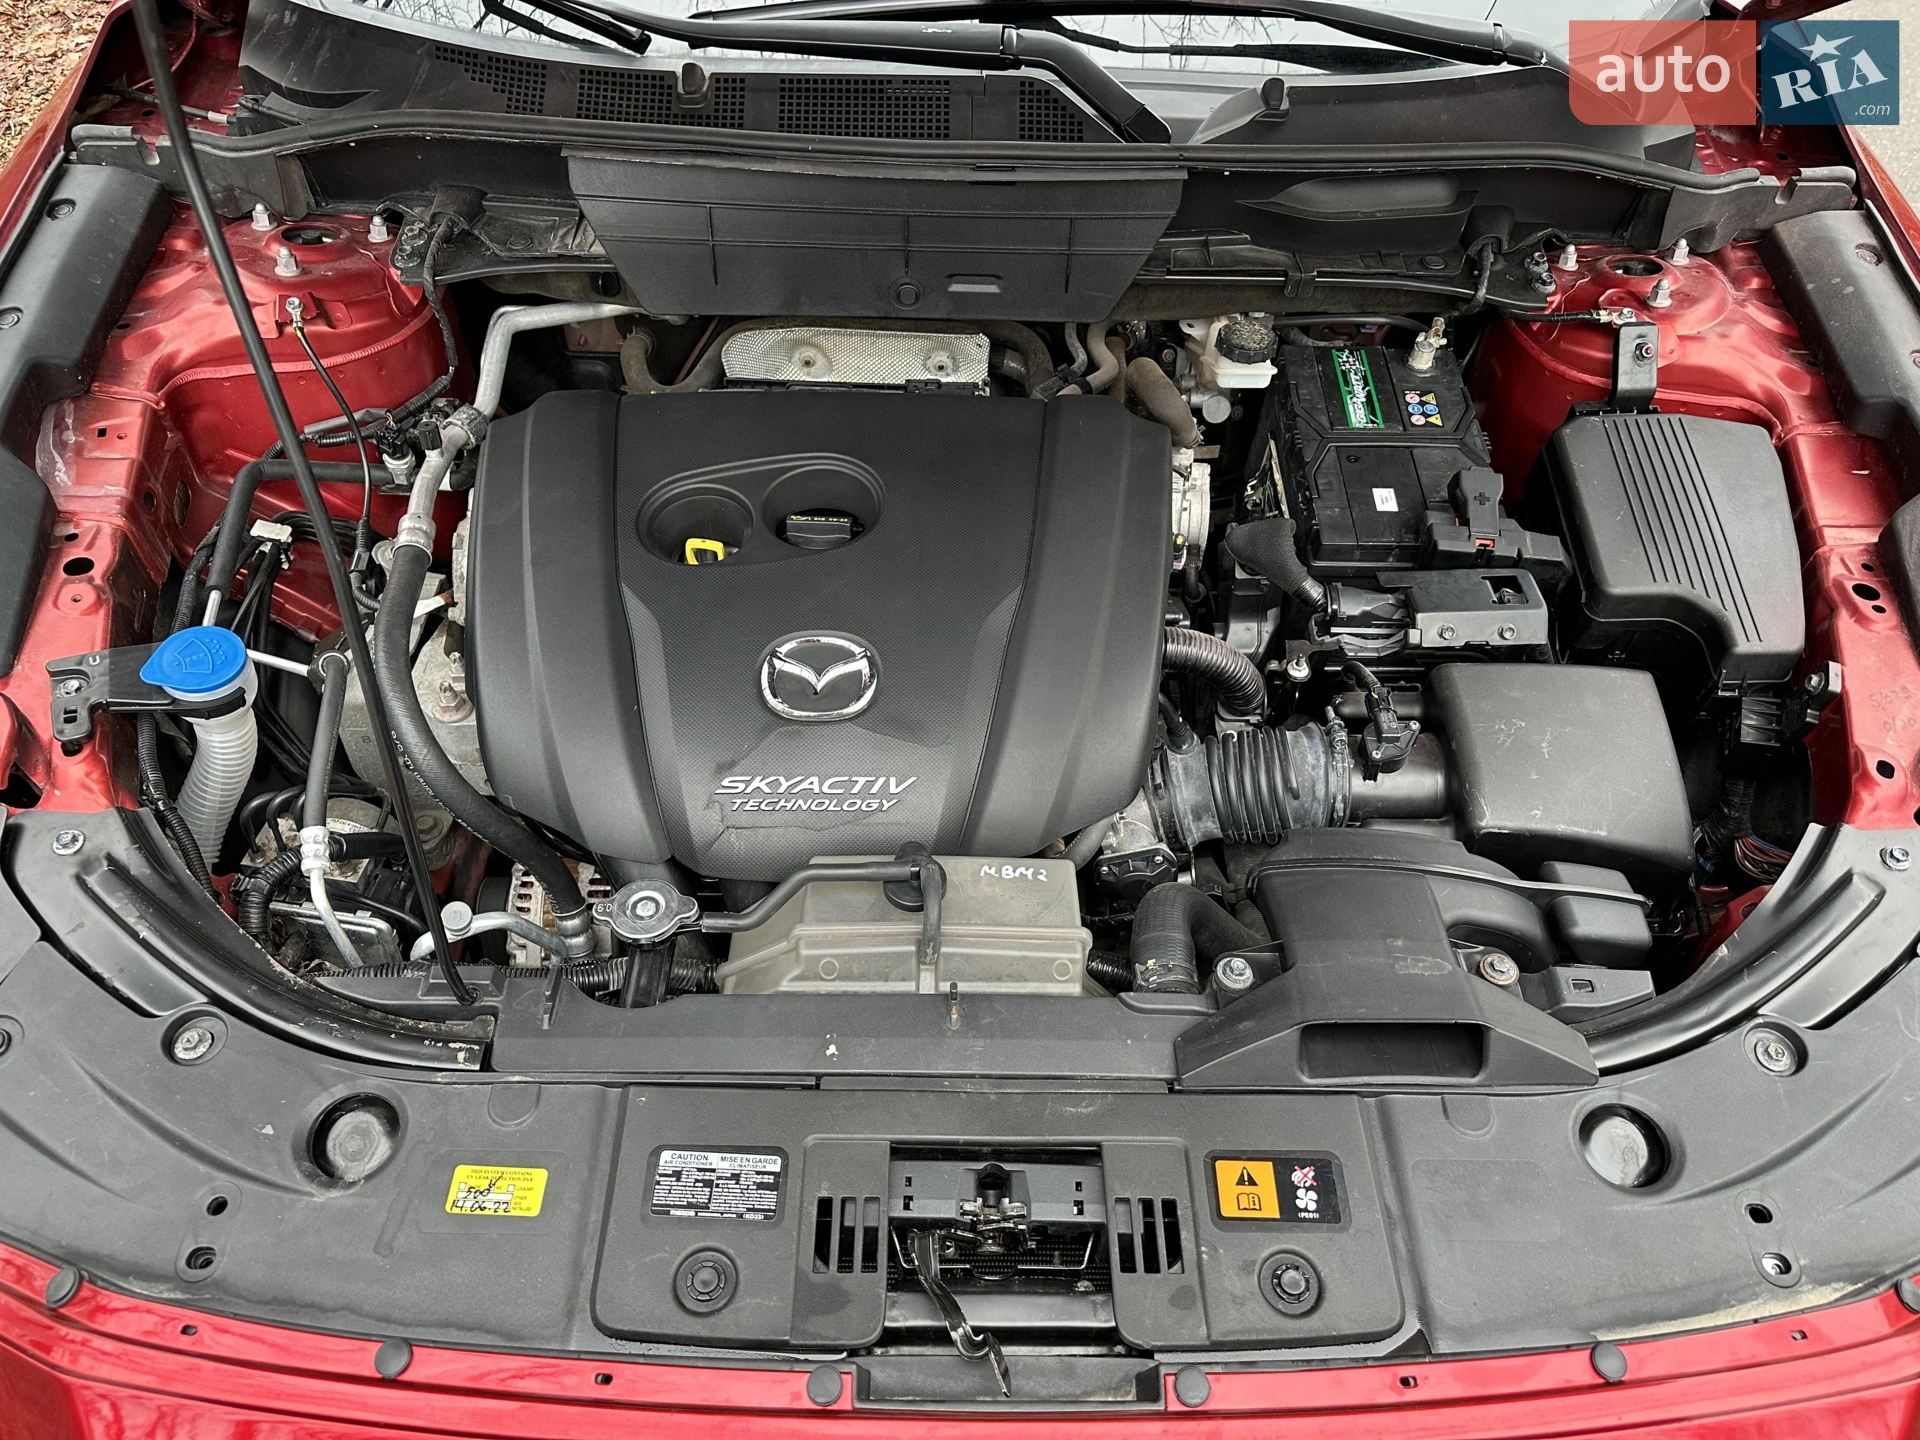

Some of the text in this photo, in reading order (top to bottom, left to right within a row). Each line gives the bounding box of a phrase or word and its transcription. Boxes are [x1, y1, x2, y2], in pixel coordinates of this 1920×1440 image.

[714, 776, 919, 795] SKYACTIV
[731, 798, 901, 812] TECHNOLOGY
[671, 1152, 709, 1161] CAUTION
[720, 1155, 739, 1163] MISE
[751, 1157, 779, 1165] GARDE
